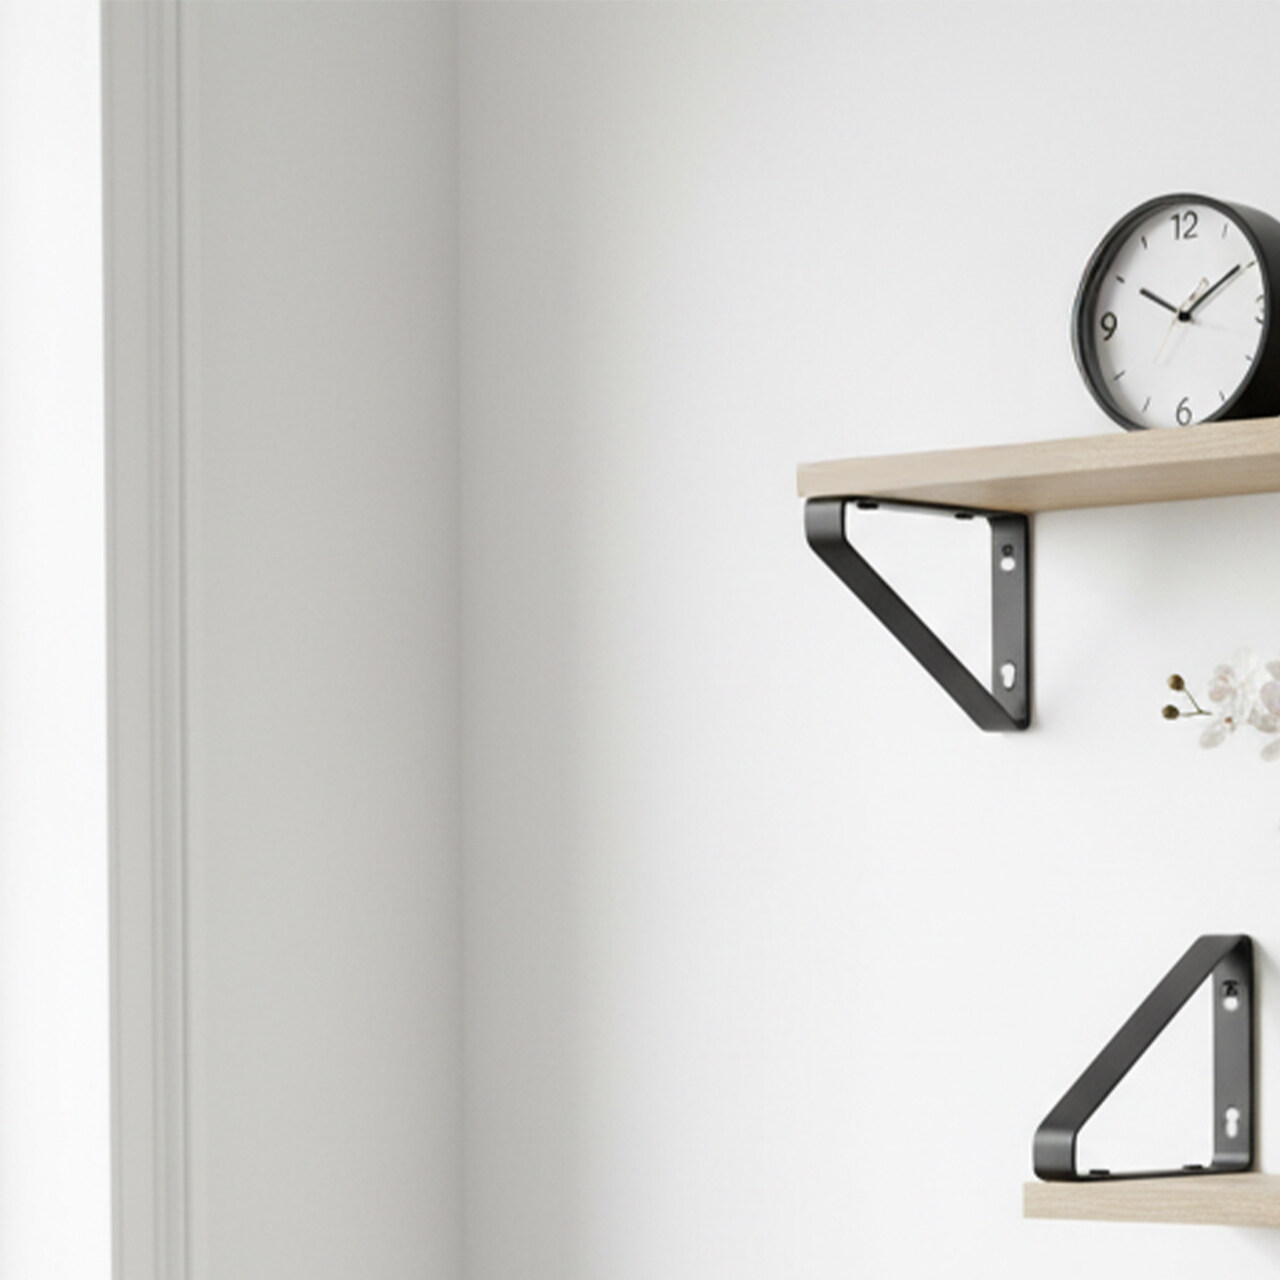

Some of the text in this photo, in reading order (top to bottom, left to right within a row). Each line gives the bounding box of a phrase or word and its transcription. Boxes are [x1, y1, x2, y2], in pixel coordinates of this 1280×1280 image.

[1171, 210, 1198, 240] 12
[1101, 312, 1118, 341] 9
[1176, 397, 1192, 426] 6
